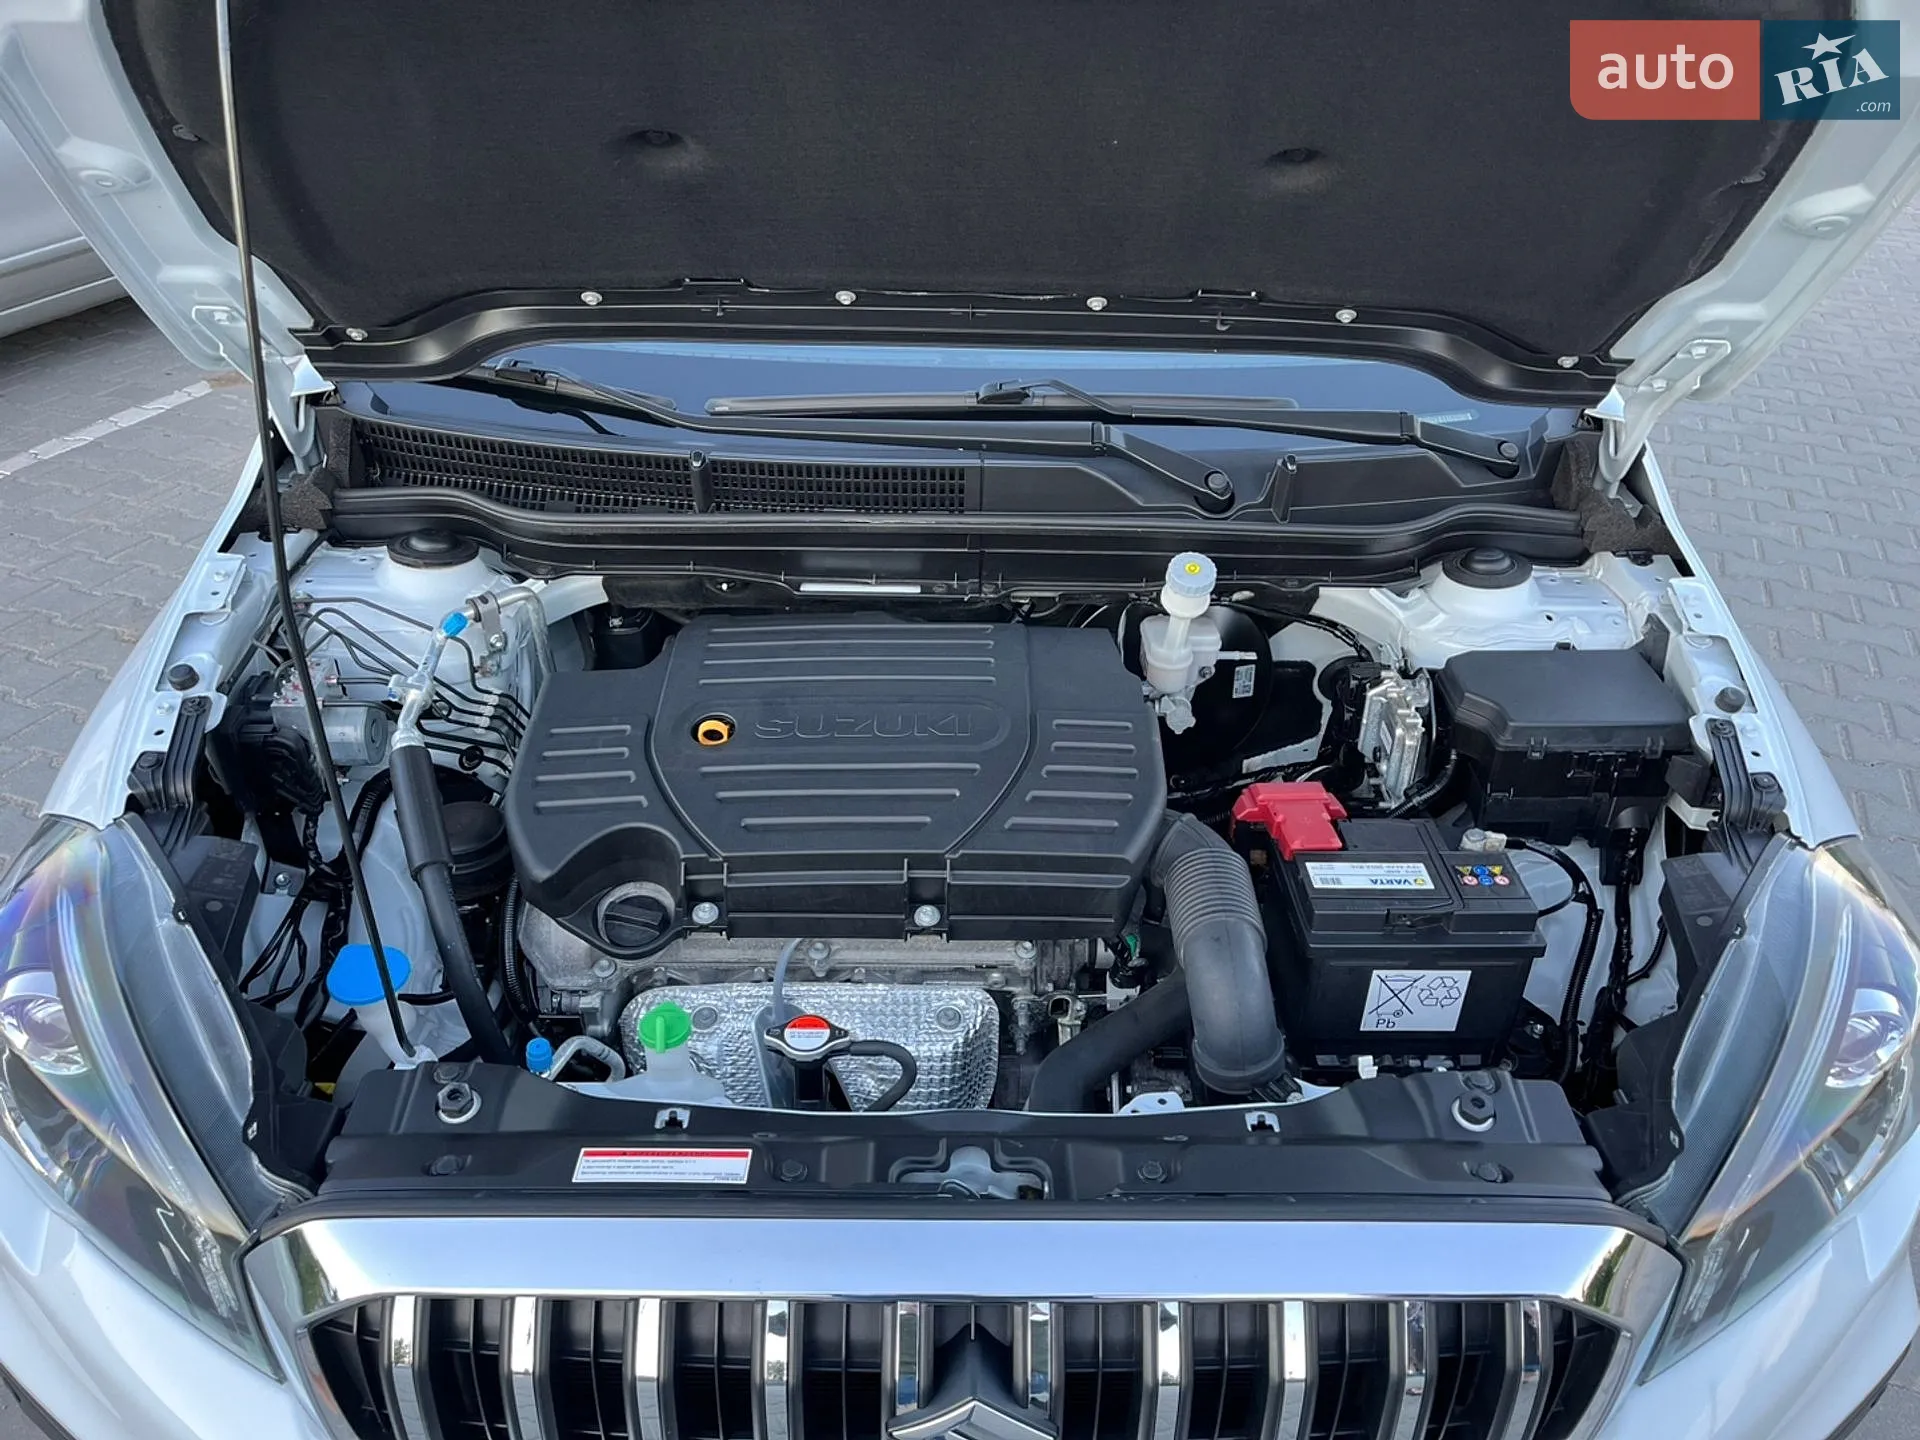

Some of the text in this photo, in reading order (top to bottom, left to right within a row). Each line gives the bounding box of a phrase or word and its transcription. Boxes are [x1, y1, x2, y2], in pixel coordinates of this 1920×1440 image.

[754, 711, 972, 739] SUZUKI
[1369, 878, 1413, 886] VARTA
[1375, 1018, 1396, 1029] Pb
